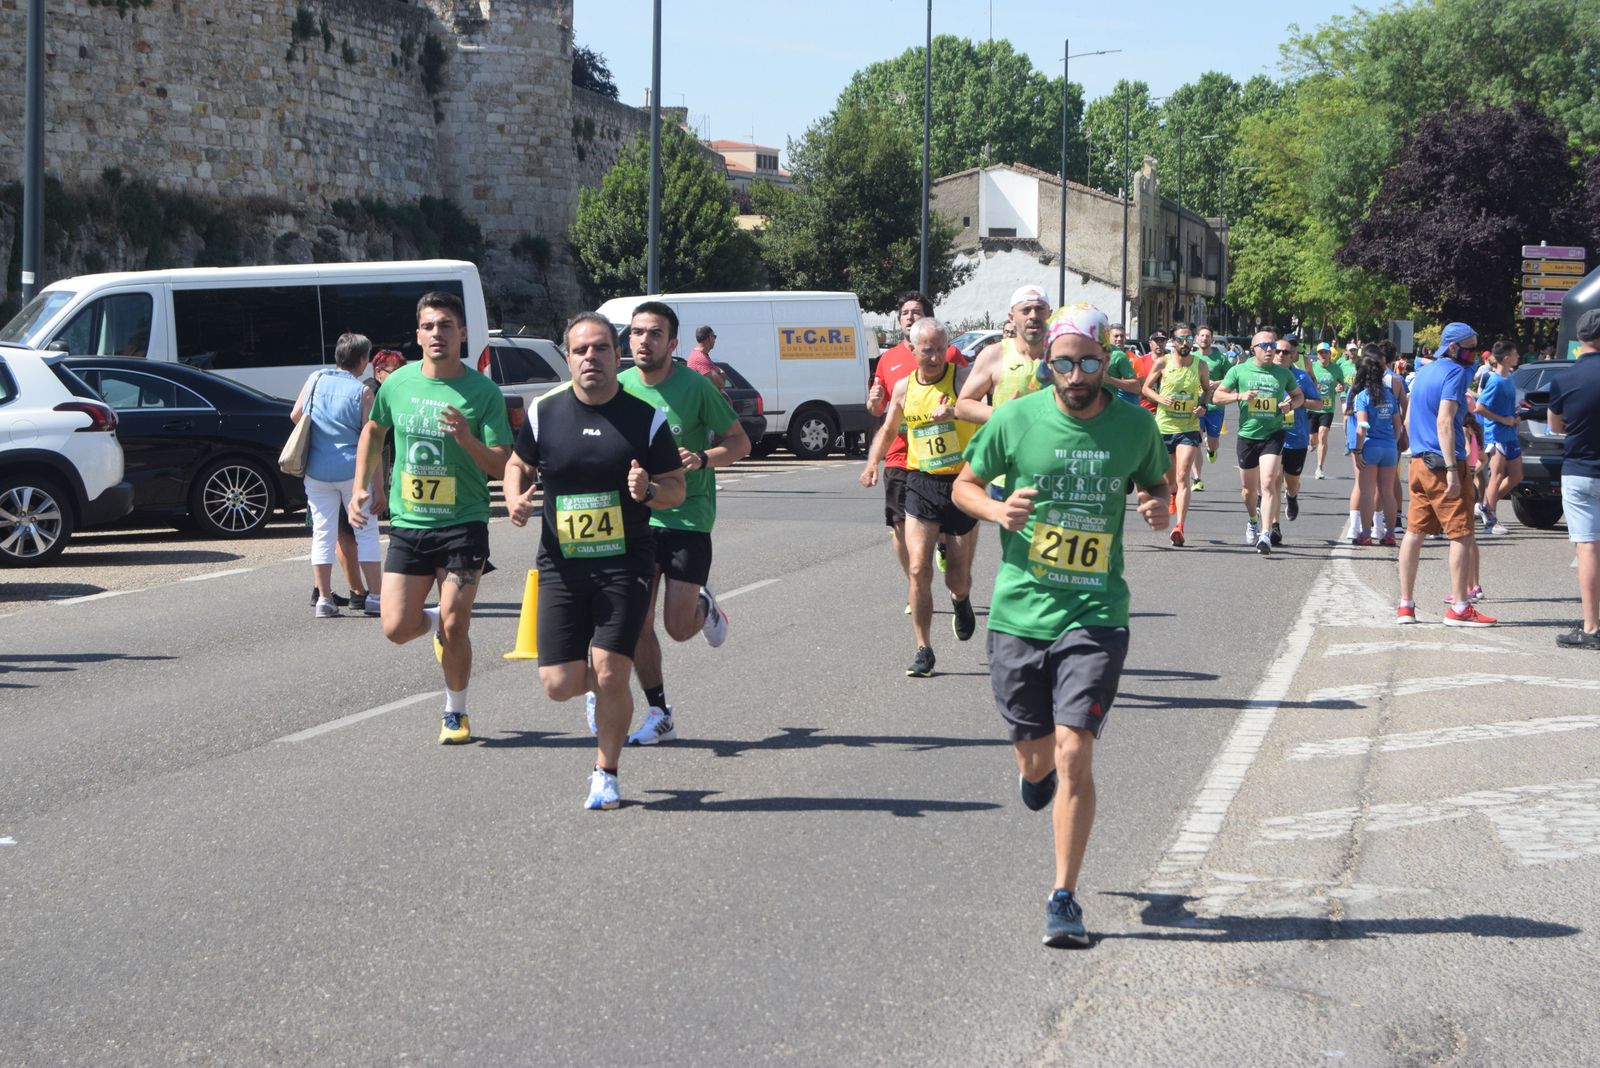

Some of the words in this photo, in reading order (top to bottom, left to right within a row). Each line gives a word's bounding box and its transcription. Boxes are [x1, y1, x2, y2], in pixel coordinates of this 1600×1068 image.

[1174, 401, 1186, 411] 61
[1254, 399, 1270, 410] 40
[582, 428, 601, 436] FILA
[926, 437, 946, 455] 18
[1055, 449, 1067, 458] VII
[1072, 450, 1110, 460] CARRERA
[411, 479, 440, 501] 37
[1052, 492, 1065, 500] DE
[1069, 492, 1106, 501] ZAMORA
[429, 506, 452, 514] RURAL
[564, 512, 614, 540] 124
[577, 544, 594, 553] CAJA
[596, 543, 622, 552] RURAL
[1040, 530, 1100, 568] 216
[1048, 572, 1070, 584] CAJA
[1071, 574, 1102, 586] RURAL
